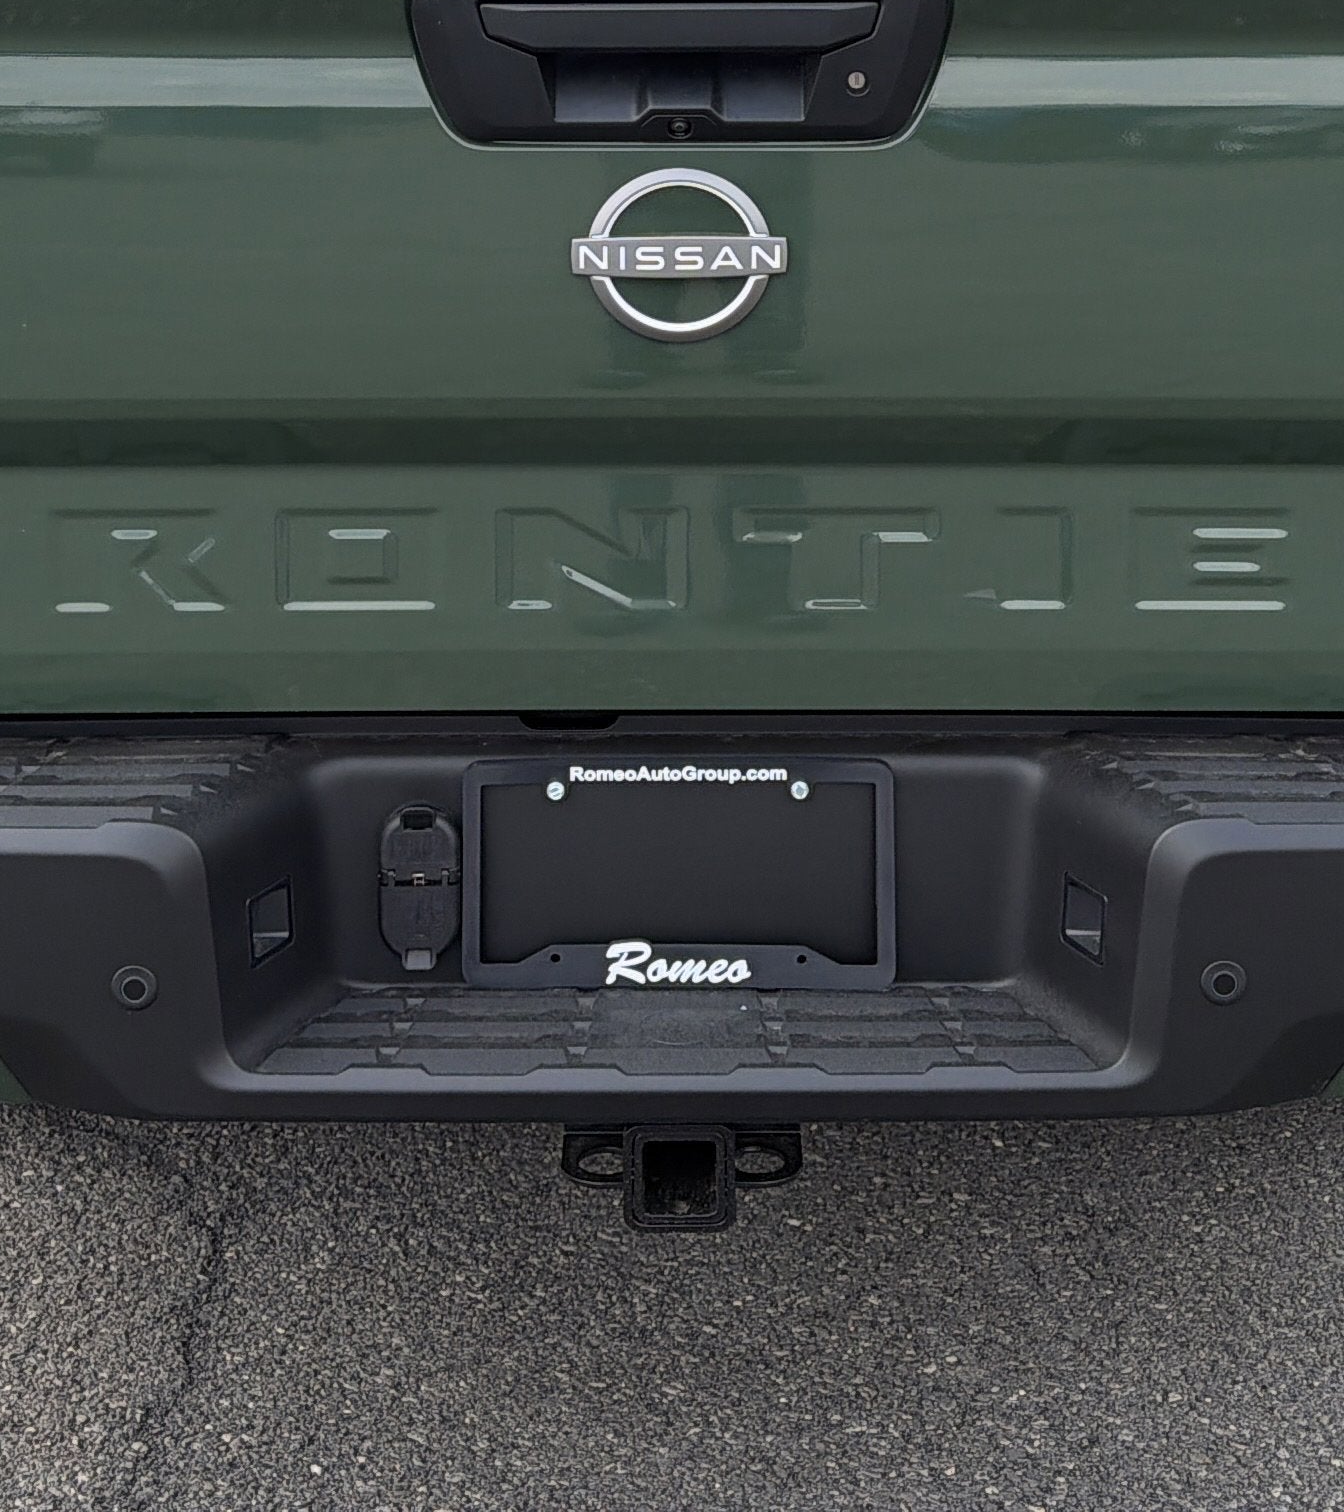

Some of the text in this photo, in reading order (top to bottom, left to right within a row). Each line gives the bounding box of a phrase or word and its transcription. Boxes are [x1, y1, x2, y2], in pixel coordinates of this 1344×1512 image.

[578, 244, 781, 271] NISSAN
[569, 765, 788, 785] RomeoAutoGroup.com
[605, 940, 753, 985] Romeo
